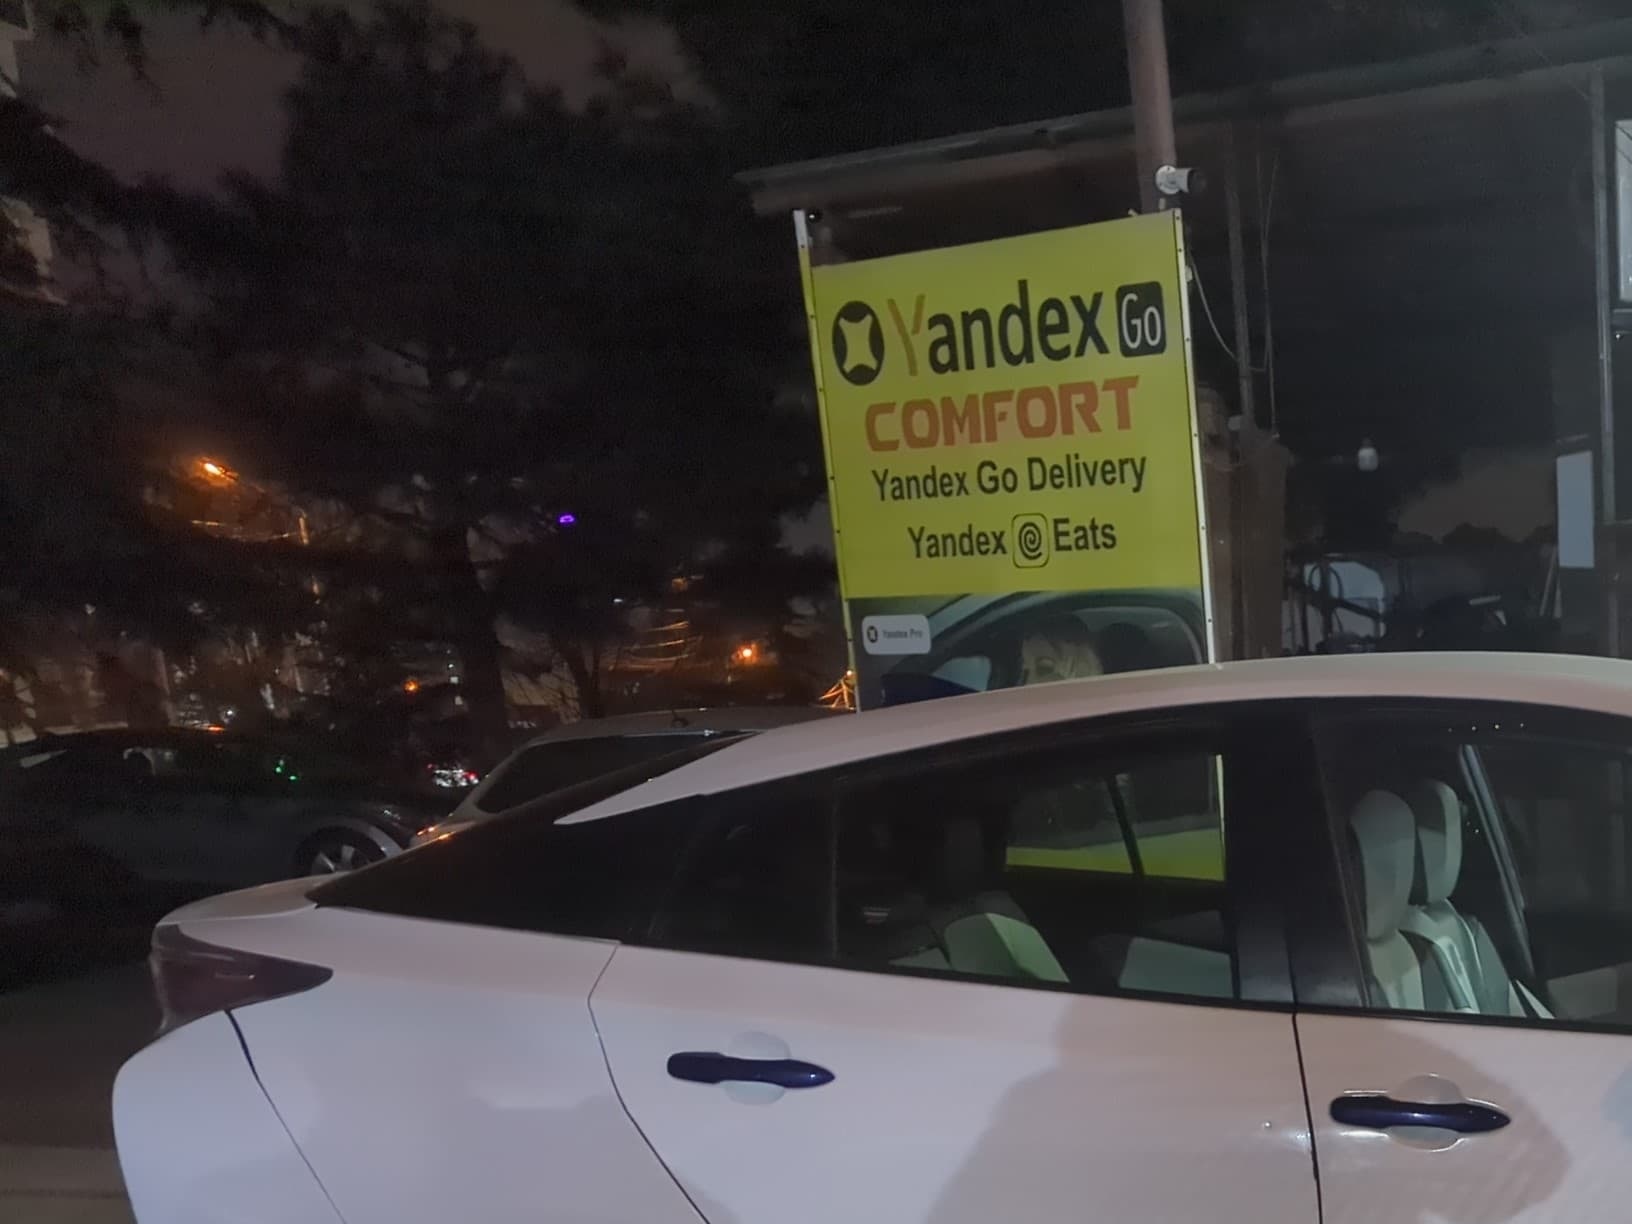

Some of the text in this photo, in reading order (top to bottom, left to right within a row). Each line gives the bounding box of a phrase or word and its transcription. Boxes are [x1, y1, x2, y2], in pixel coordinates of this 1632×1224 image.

[887, 279, 1162, 377] Yandex Go
[865, 375, 1140, 453] COMFORT
[872, 454, 1147, 502] Yandex Go Delivery
[908, 518, 1117, 559] Yandex Eats
